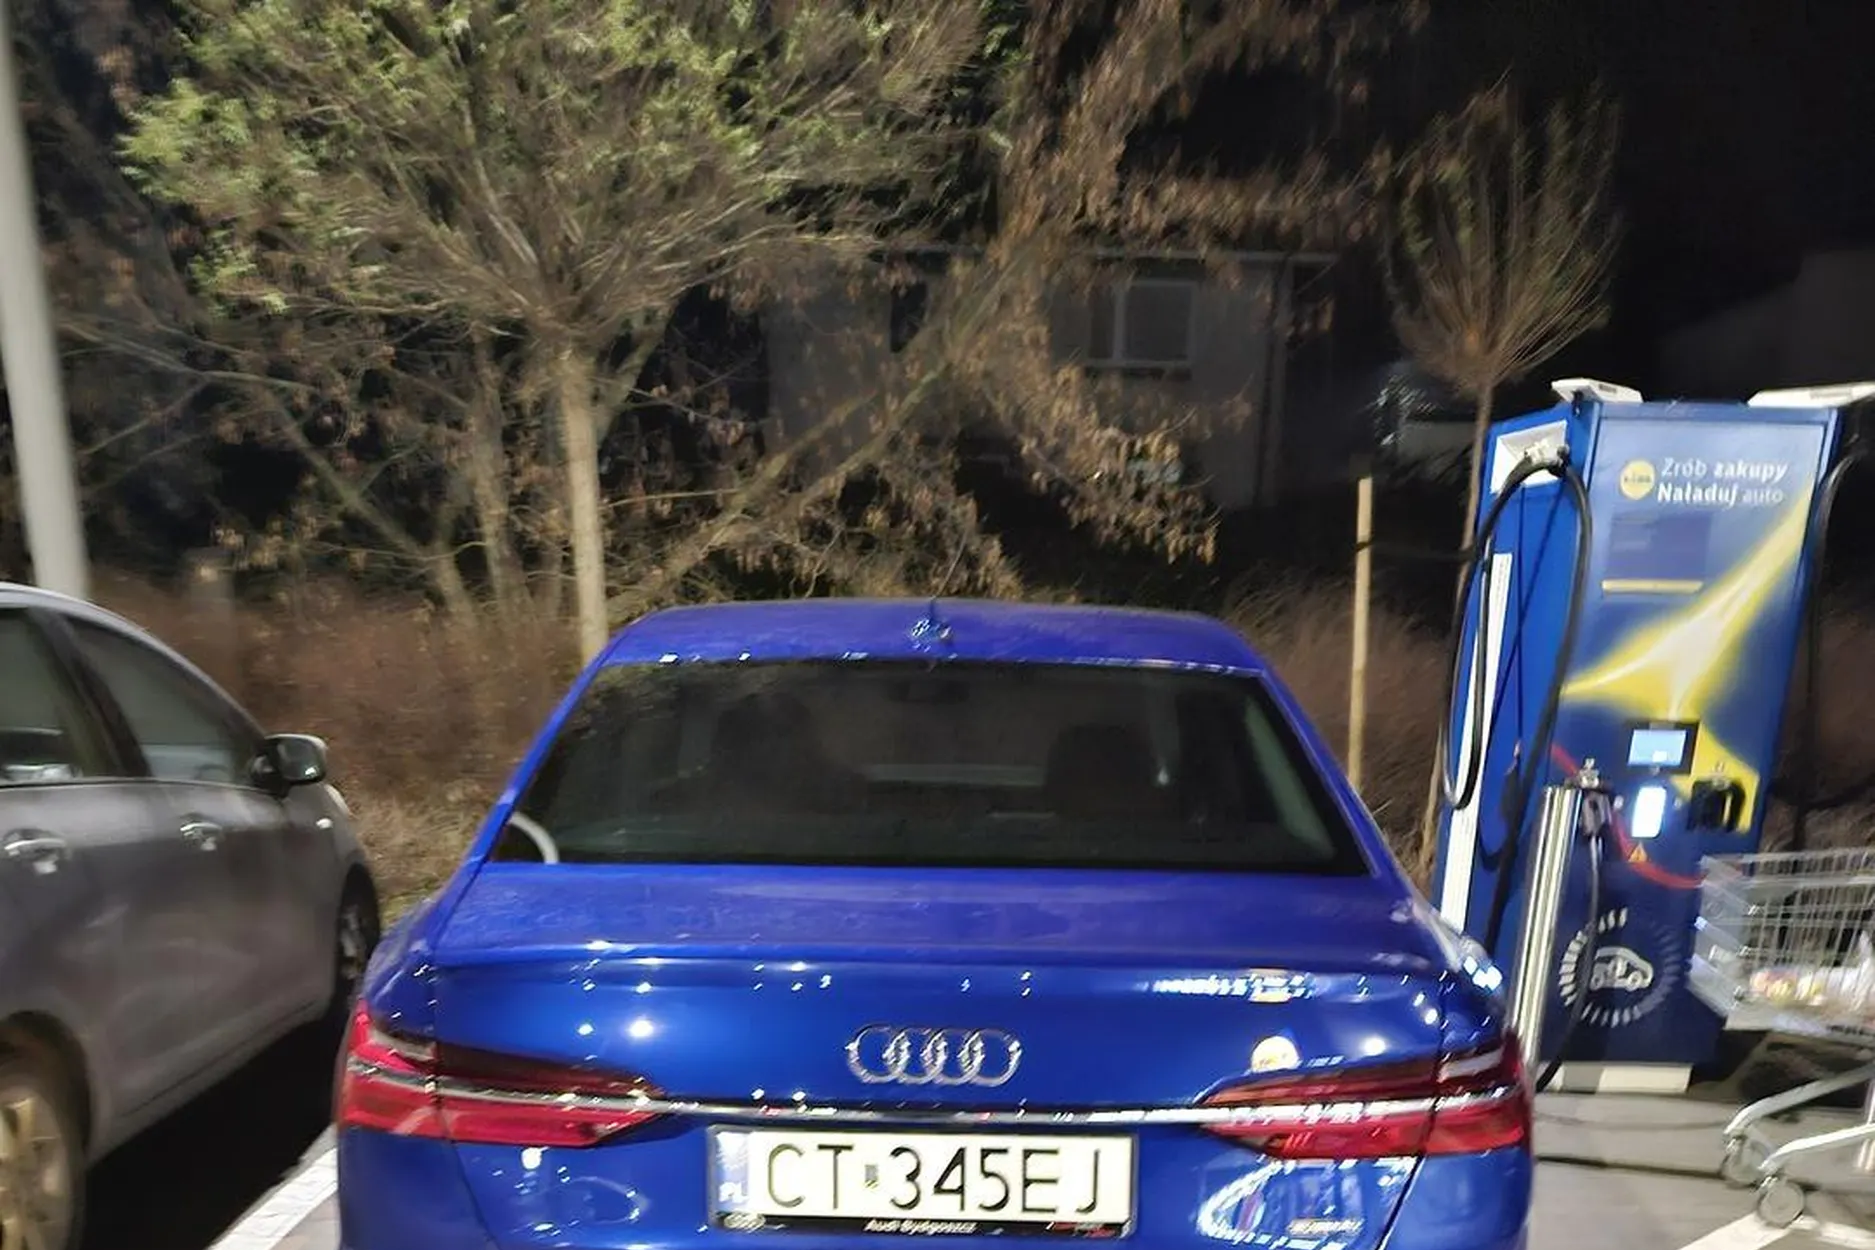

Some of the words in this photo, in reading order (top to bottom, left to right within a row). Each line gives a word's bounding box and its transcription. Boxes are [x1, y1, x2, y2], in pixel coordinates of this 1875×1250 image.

[1661, 458, 1707, 477] Zrób
[1713, 460, 1788, 483] zakupy
[1742, 489, 1783, 504] auto
[768, 1143, 854, 1210] CT
[889, 1146, 1101, 1213] 345EJ
